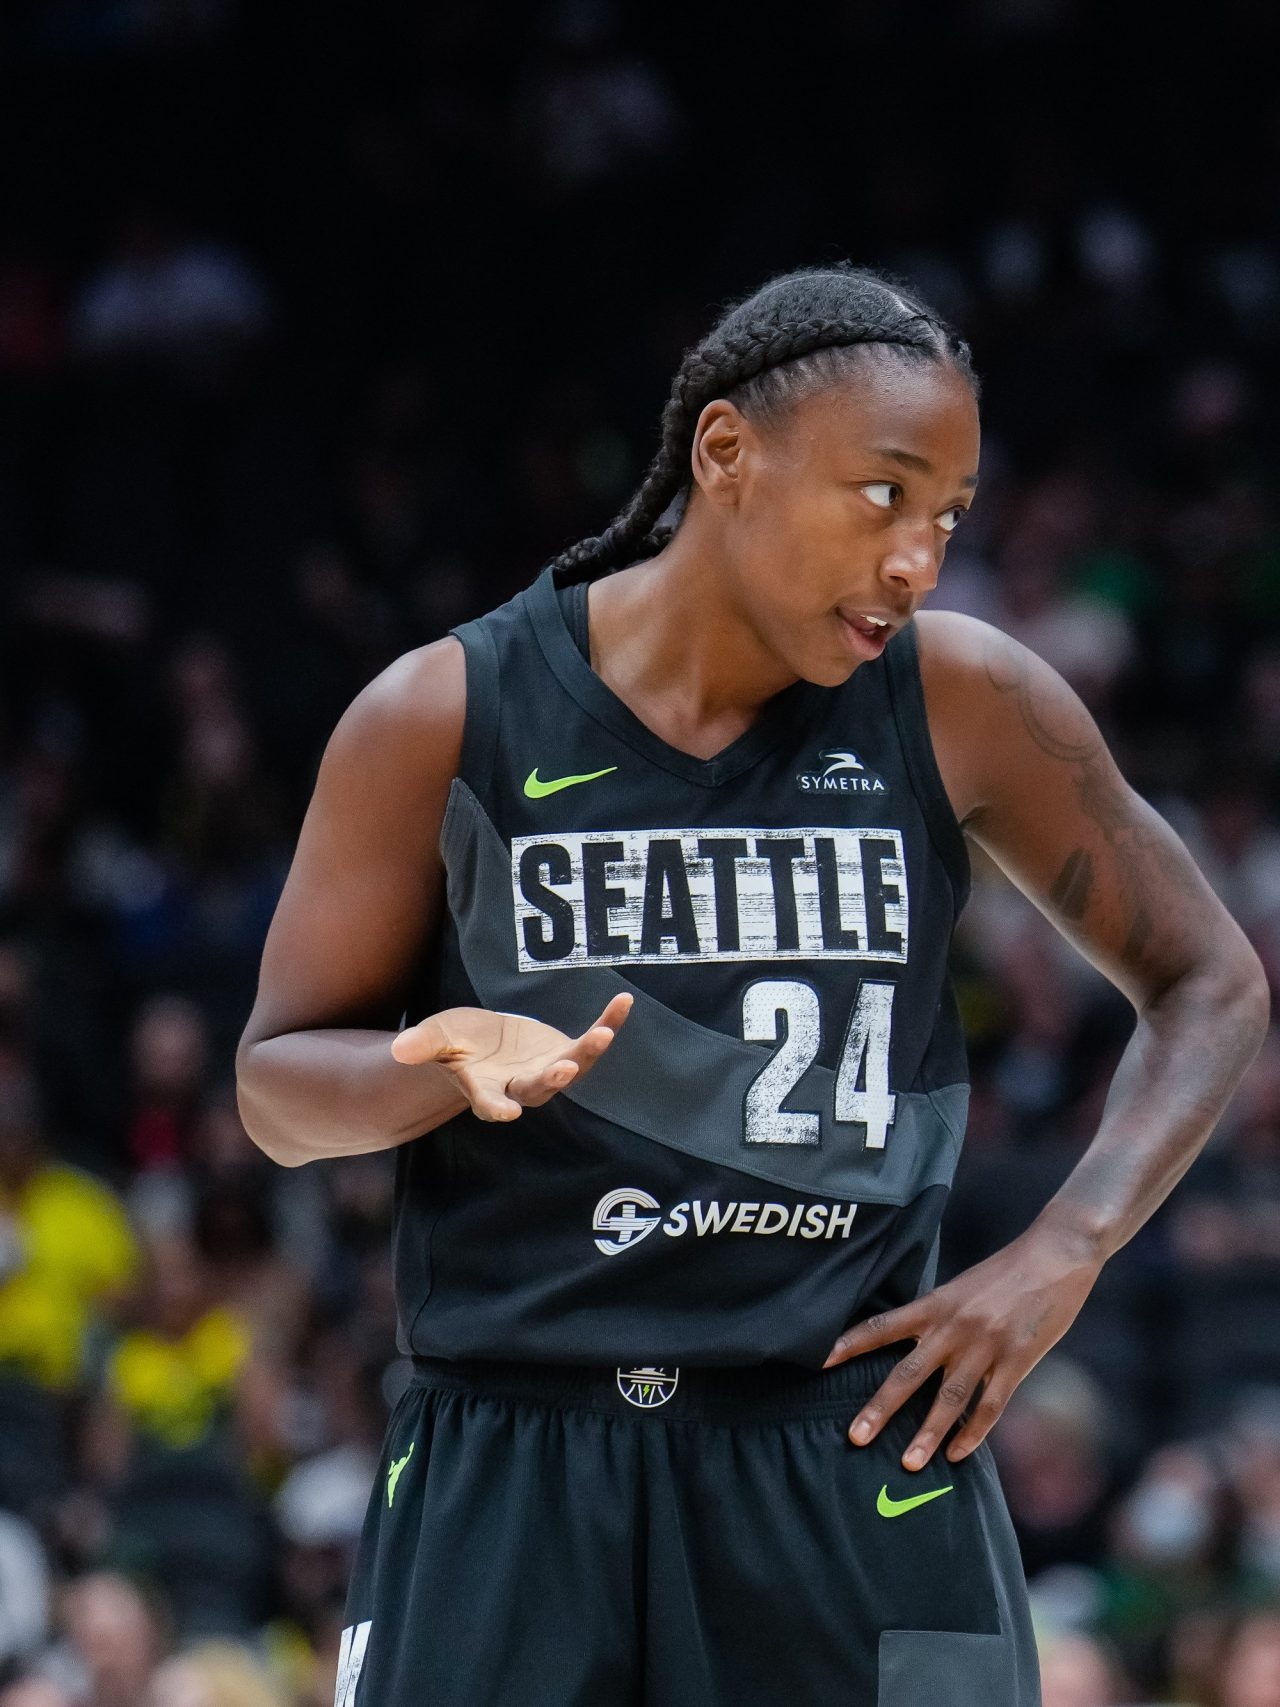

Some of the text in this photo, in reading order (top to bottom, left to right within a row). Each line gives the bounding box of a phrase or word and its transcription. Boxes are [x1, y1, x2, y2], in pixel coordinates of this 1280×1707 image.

[801, 776, 885, 791] SYMETRA
[518, 836, 904, 962] SEATTLE
[742, 978, 896, 1150] 24
[662, 1200, 858, 1240] SWEDISH
